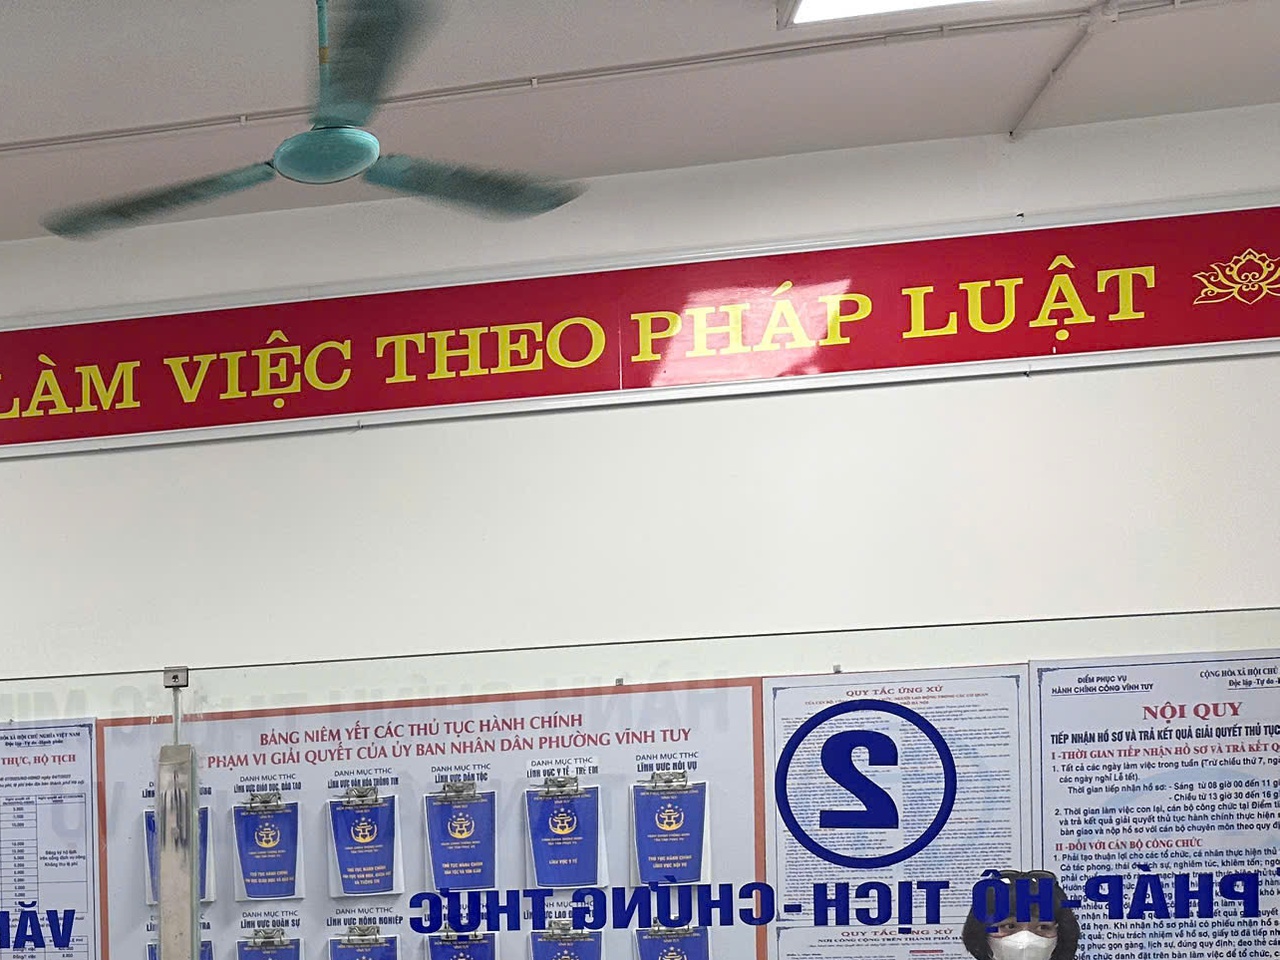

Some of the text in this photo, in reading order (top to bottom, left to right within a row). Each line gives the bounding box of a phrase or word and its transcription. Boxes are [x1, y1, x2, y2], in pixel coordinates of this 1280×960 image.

[163, 329, 353, 407] VIỆC
[376, 317, 606, 384] THEO
[629, 281, 874, 363] PHÁP
[901, 254, 1157, 341] LUẬT
[1142, 701, 1243, 724] NỘI QUY
[260, 711, 582, 746] BẢNG NIÊM YẾT CÁC THỦ TỤC HÀNH CHÍNH
[1051, 731, 1069, 744] TIẾP
[1071, 731, 1095, 745] NHẬN
[1111, 731, 1124, 742] SƠ
[1125, 729, 1137, 741] VÀ
[1139, 727, 1155, 740] TRẢ
[1157, 726, 1173, 740] KẾT
[1175, 726, 1193, 740] QUẢ
[1195, 724, 1213, 738] GIẢI
[1215, 723, 1242, 738] QUYẾT
[1244, 722, 1261, 736] THỦ
[2, 755, 31, 767] THỰC,
[33, 754, 48, 766] HỘ
[50, 753, 76, 765] TỊCH
[208, 728, 691, 771] PHẠM VI GIẢI QUYẾT CỦA ỦY BAN NHÂN DÂN PHƯỜNG VĨNH TUY
[679, 751, 699, 759] TTHC
[1090, 739, 1269, 759] GIAN TIẾP NHẬN HỒ SƠ VÀ TRẢ KẾT
[1088, 838, 1203, 851] VỚI CÁN BỘ CÔNG CHỨC
